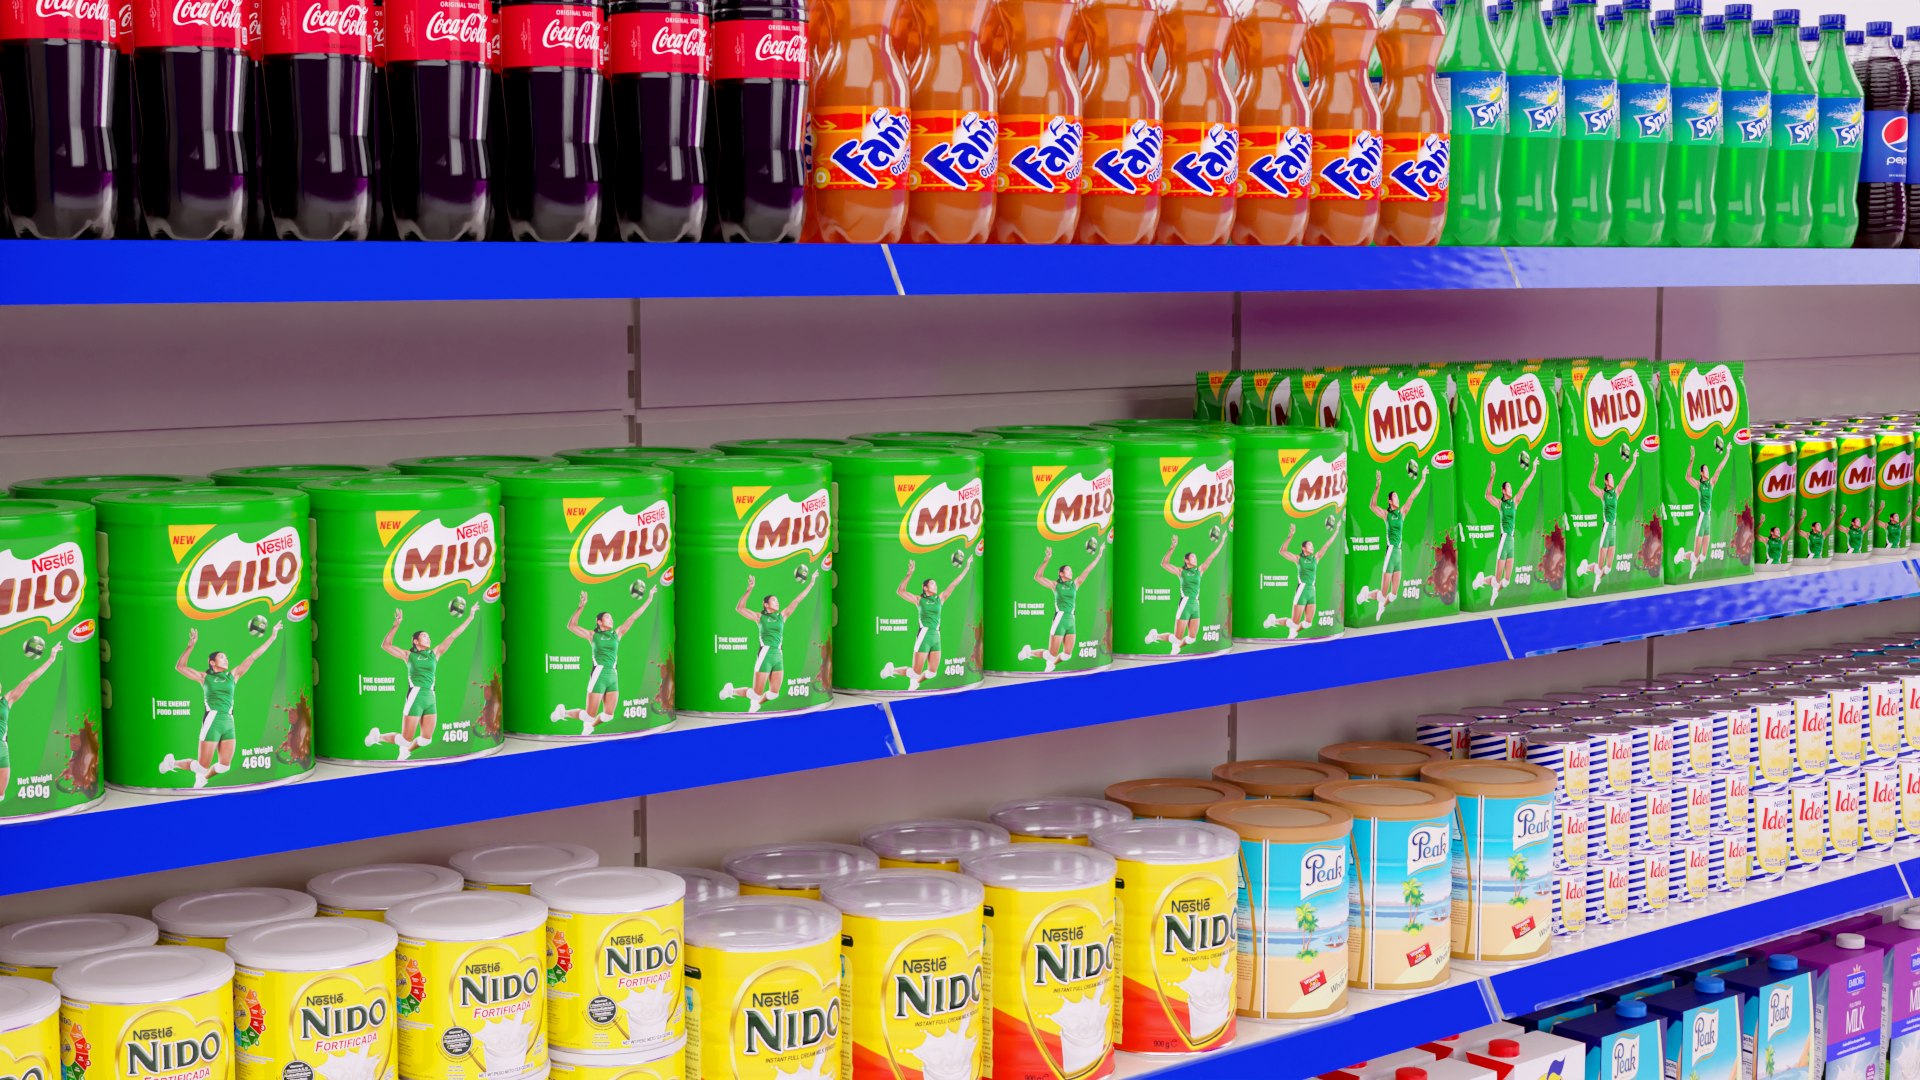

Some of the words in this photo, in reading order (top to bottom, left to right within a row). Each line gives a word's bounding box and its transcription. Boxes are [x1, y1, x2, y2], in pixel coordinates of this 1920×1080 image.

[440, 1, 466, 9] ORIGINAL
[302, 3, 369, 36] Coca-Cola
[426, 11, 488, 43] Coca-Cola
[768, 24, 791, 32] ORIGINAL
[542, 19, 601, 50] Coca-Cola
[652, 26, 707, 57] Coca-Cola
[755, 34, 807, 62] Coca-Cola
[830, 115, 910, 188] Fanta
[1210, 377, 1222, 385] NEW
[1255, 379, 1267, 387] NEW
[1303, 380, 1316, 388] NEW
[1509, 380, 1535, 396] Nestlé
[1610, 375, 1634, 391] Nestlé
[1397, 386, 1424, 402] Nestlé
[1590, 389, 1640, 428] MILO
[1686, 384, 1734, 422] MILO
[1372, 400, 1431, 443] MILO
[1487, 394, 1542, 435] MILO
[1281, 456, 1297, 464] NEW
[1035, 474, 1052, 482] NEW
[898, 484, 916, 492] NEW
[1178, 478, 1233, 513] MILO
[736, 496, 755, 504] NEW
[801, 496, 826, 514] Nestlé
[1052, 488, 1112, 524] MILO
[566, 507, 587, 516] NEW
[637, 508, 666, 526] Nestlé
[915, 498, 981, 537] MILO
[380, 521, 401, 530] NEW
[456, 520, 489, 541] Nestlé
[755, 510, 828, 550] MILO
[172, 536, 196, 544] NEW
[256, 534, 294, 556] Nestlé
[587, 522, 669, 566] MILO
[31, 549, 75, 574] Nestlé
[402, 536, 492, 582] MILO
[1616, 560, 1631, 572] 460g
[197, 551, 298, 599] MILO
[1514, 572, 1531, 584] 460g
[0, 568, 80, 615] ILO
[1402, 586, 1420, 599] 460g
[1318, 616, 1334, 627] 460g
[1202, 631, 1220, 643] 460g
[1078, 646, 1097, 658] 460g
[944, 664, 964, 676] 460g
[788, 685, 810, 697] 460g
[168, 700, 190, 708] ENERGY
[624, 706, 648, 719] 460g
[442, 730, 468, 743] 460g
[242, 748, 254, 756] Net
[254, 746, 273, 756] Weight
[242, 756, 271, 769] 460g
[18, 776, 31, 785] Net
[32, 774, 52, 784] Weight
[18, 786, 50, 800] 460g
[1518, 808, 1550, 838] Peak
[1412, 830, 1446, 862] Peak
[1306, 854, 1342, 886] Peak
[1171, 898, 1210, 913] Nestlé
[610, 934, 644, 946] Nestlé
[1042, 926, 1083, 942] Nestlé
[606, 939, 678, 976] NIDO
[903, 956, 947, 974] Nestlé
[465, 962, 500, 975] Nestlé
[460, 967, 538, 1006] NIDO
[618, 971, 671, 988] FORTIFICADA
[1848, 976, 1864, 989] EMBORG
[306, 993, 344, 1006] Nestlé
[752, 990, 800, 1007] Nestlé
[896, 965, 982, 1017] NIDO
[301, 998, 386, 1038] NIDO
[473, 1000, 531, 1019] FORTIFICADA
[1770, 992, 1789, 1027] Peak
[745, 997, 840, 1052] NIDO
[936, 1018, 947, 1026] FULL
[1846, 1005, 1866, 1036] MILK
[132, 1026, 173, 1041] Nestlé
[316, 1032, 378, 1052] FORTIFICADA
[1694, 1017, 1716, 1052] Peak
[128, 1031, 221, 1074] NIDO
[766, 1056, 787, 1064] INSTANT
[1614, 1042, 1636, 1080] Peak
